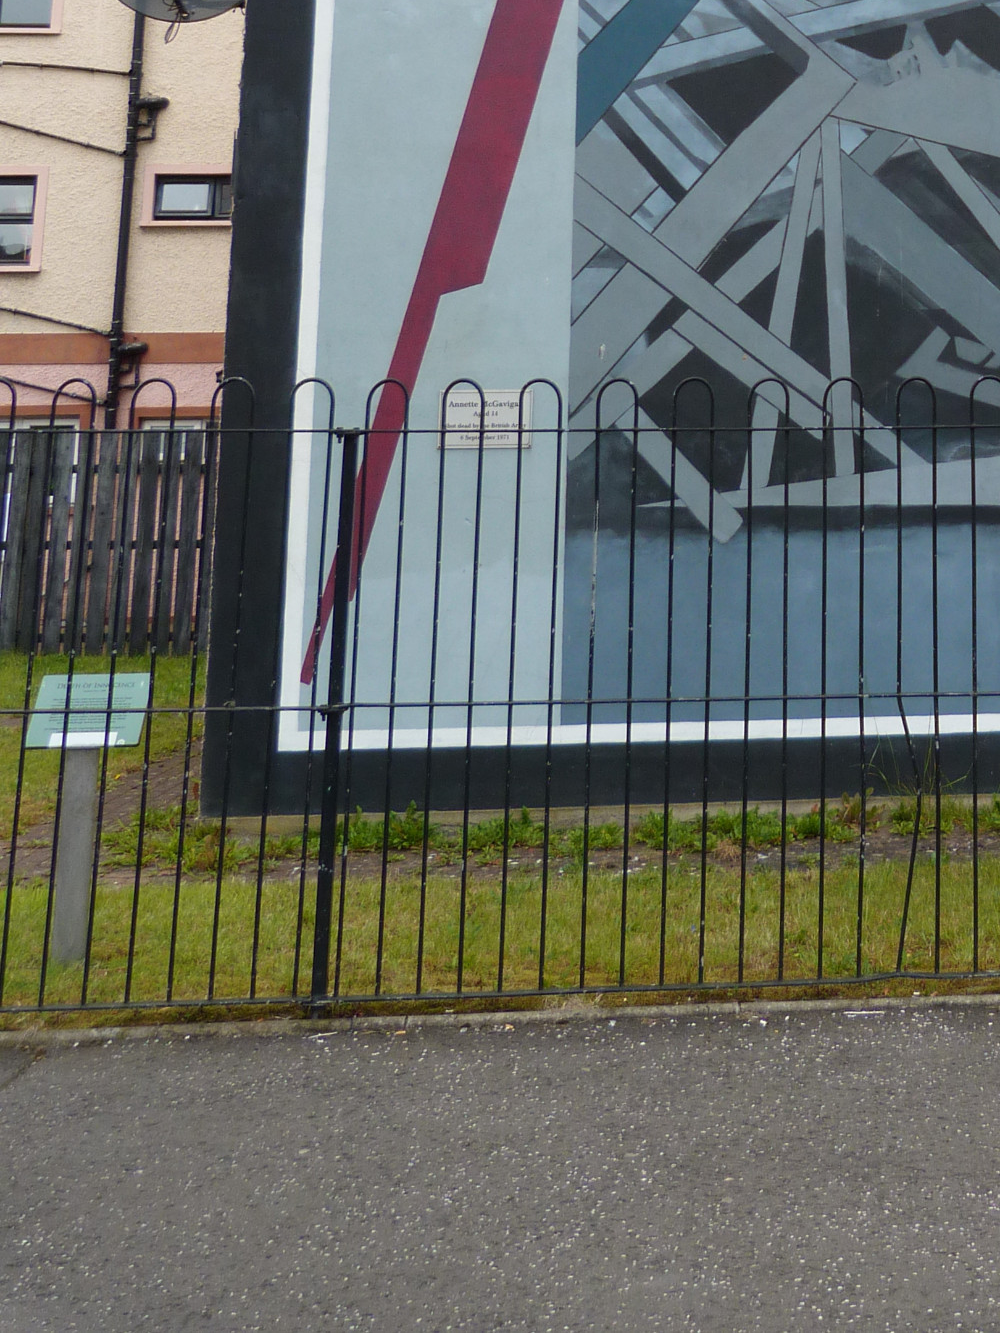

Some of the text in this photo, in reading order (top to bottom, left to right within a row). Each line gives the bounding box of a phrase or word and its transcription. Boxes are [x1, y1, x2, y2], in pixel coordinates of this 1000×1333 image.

[482, 400, 519, 409] McGaviga
[511, 422, 526, 430] Ary
[465, 434, 495, 442] Septeber
